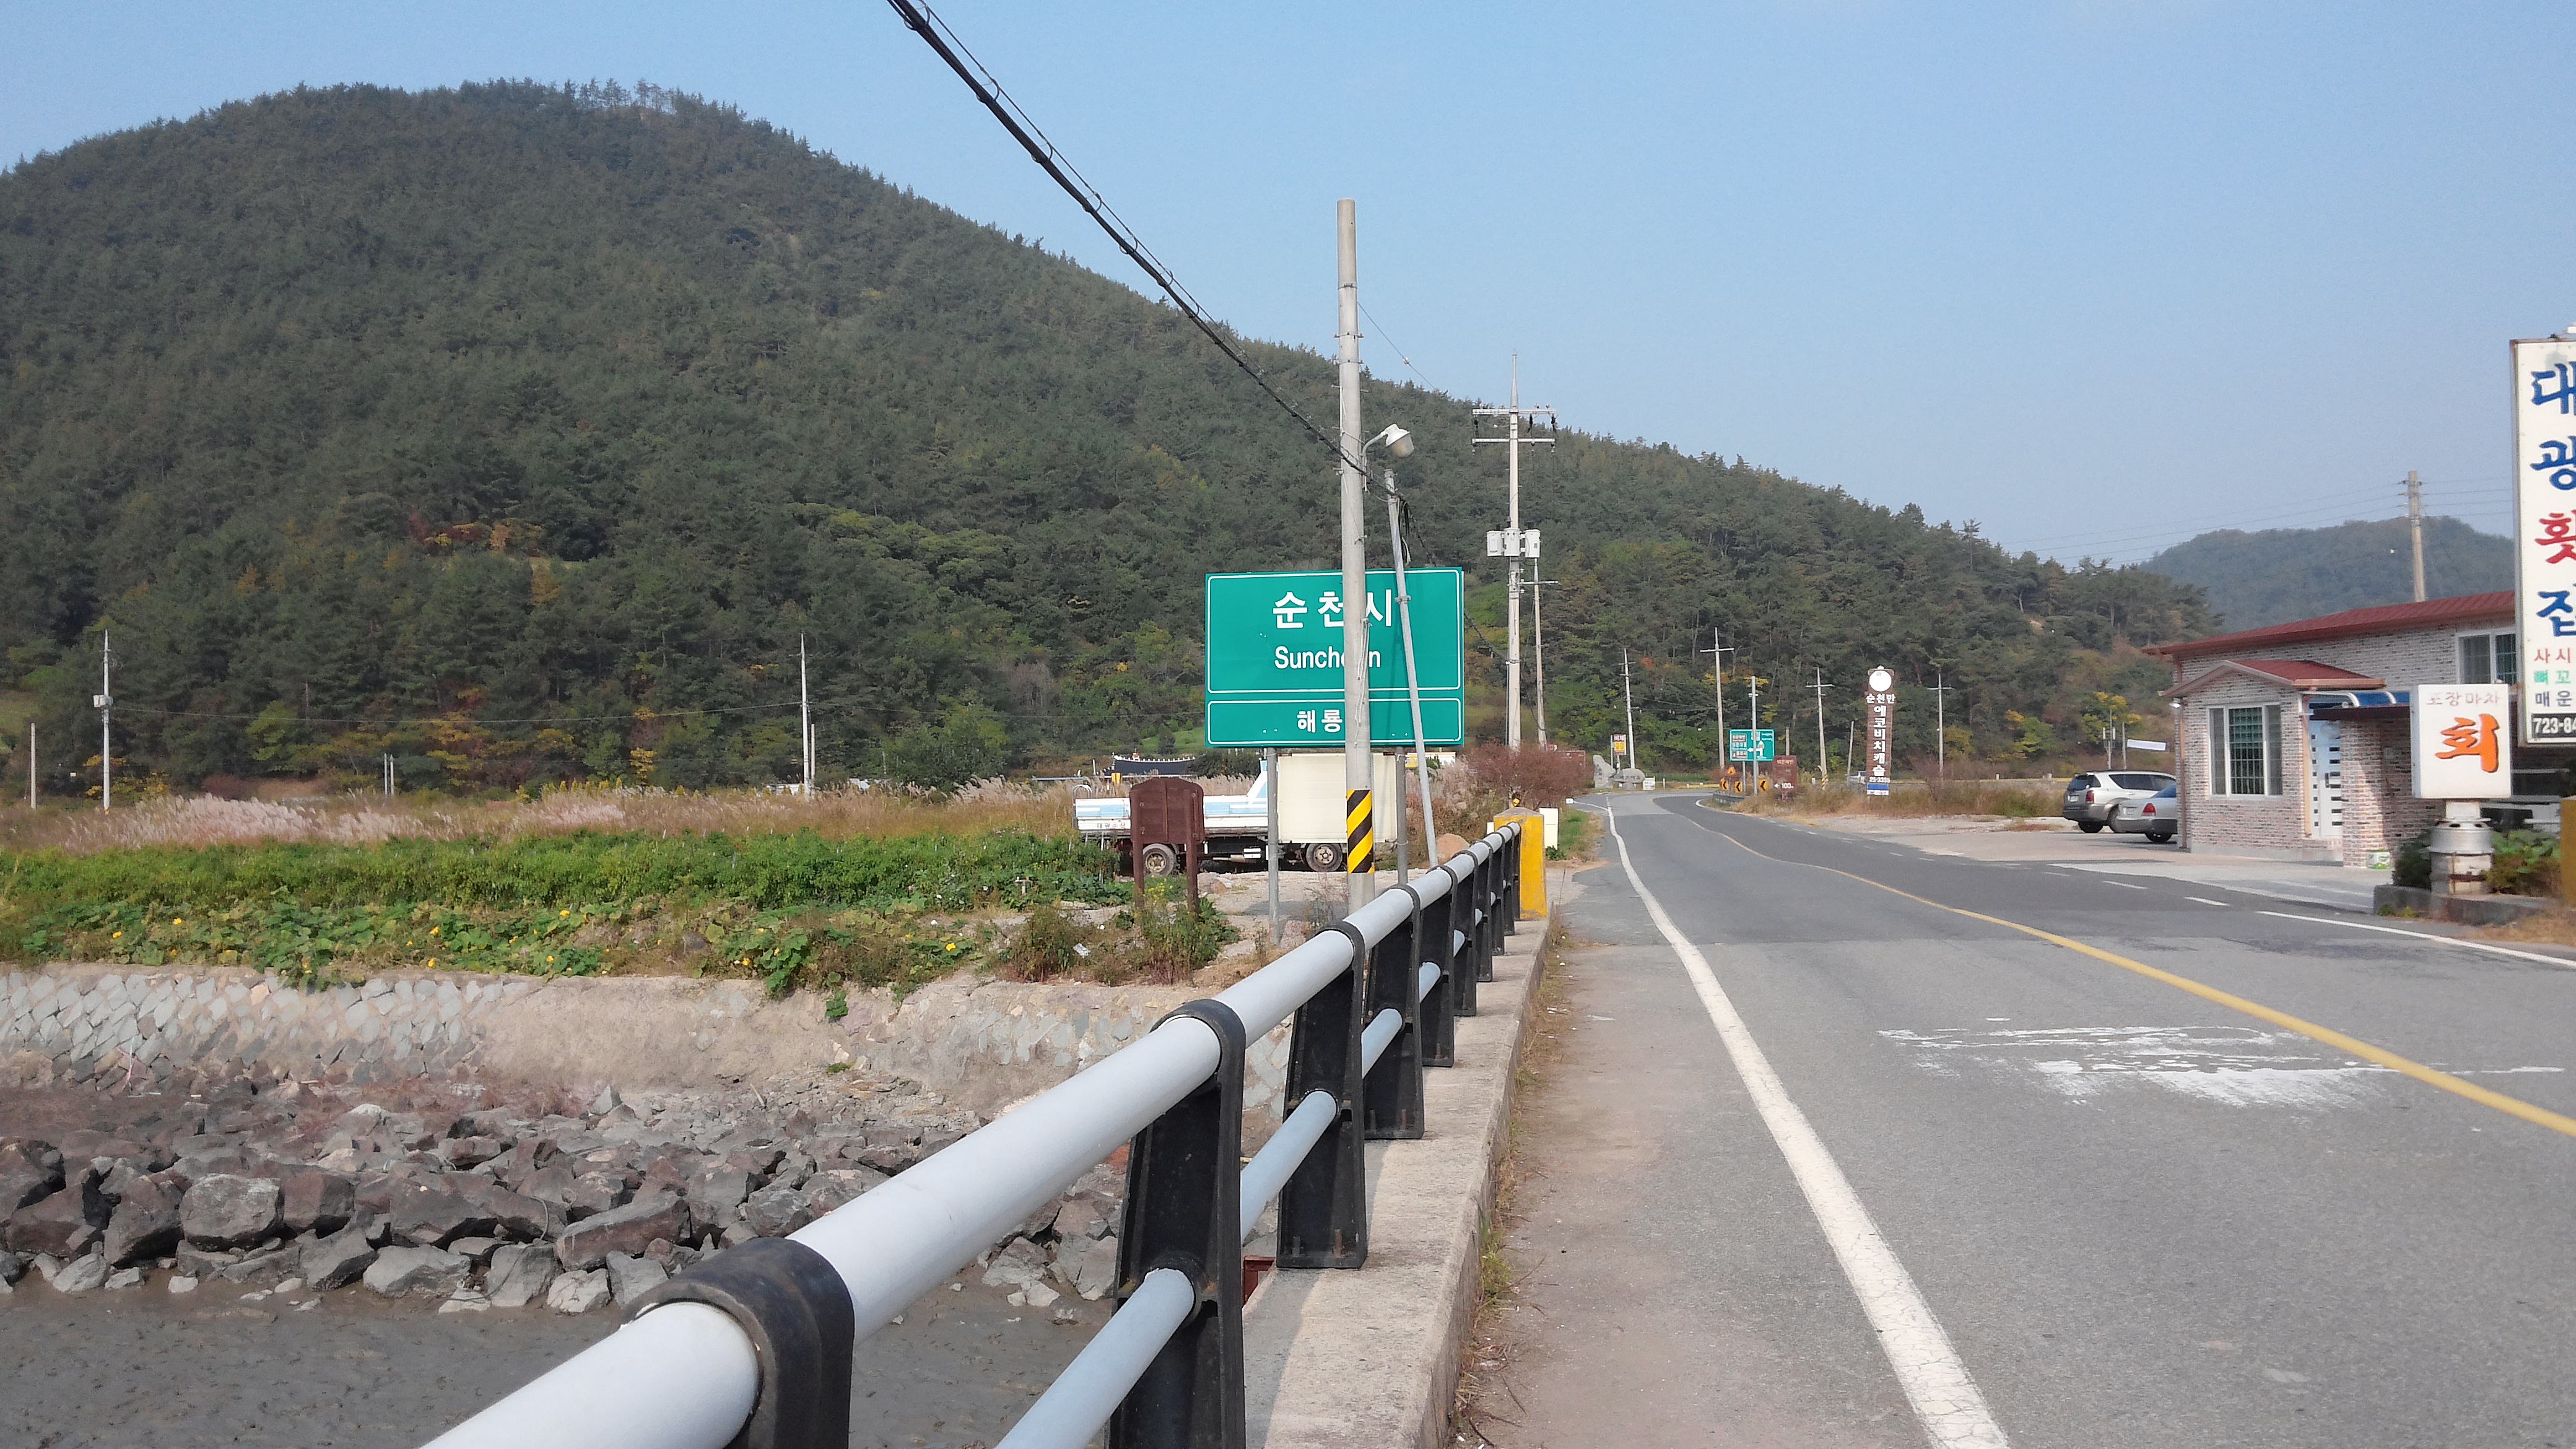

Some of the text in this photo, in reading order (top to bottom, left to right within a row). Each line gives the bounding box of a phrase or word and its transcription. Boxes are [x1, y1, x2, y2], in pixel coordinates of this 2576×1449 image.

[1273, 590, 1392, 629] 순천시
[1274, 646, 1381, 669] Sunchn
[1866, 694, 1896, 704] 순천만
[1872, 705, 1887, 777] 에코비치캐슬
[2435, 714, 2499, 773] 회
